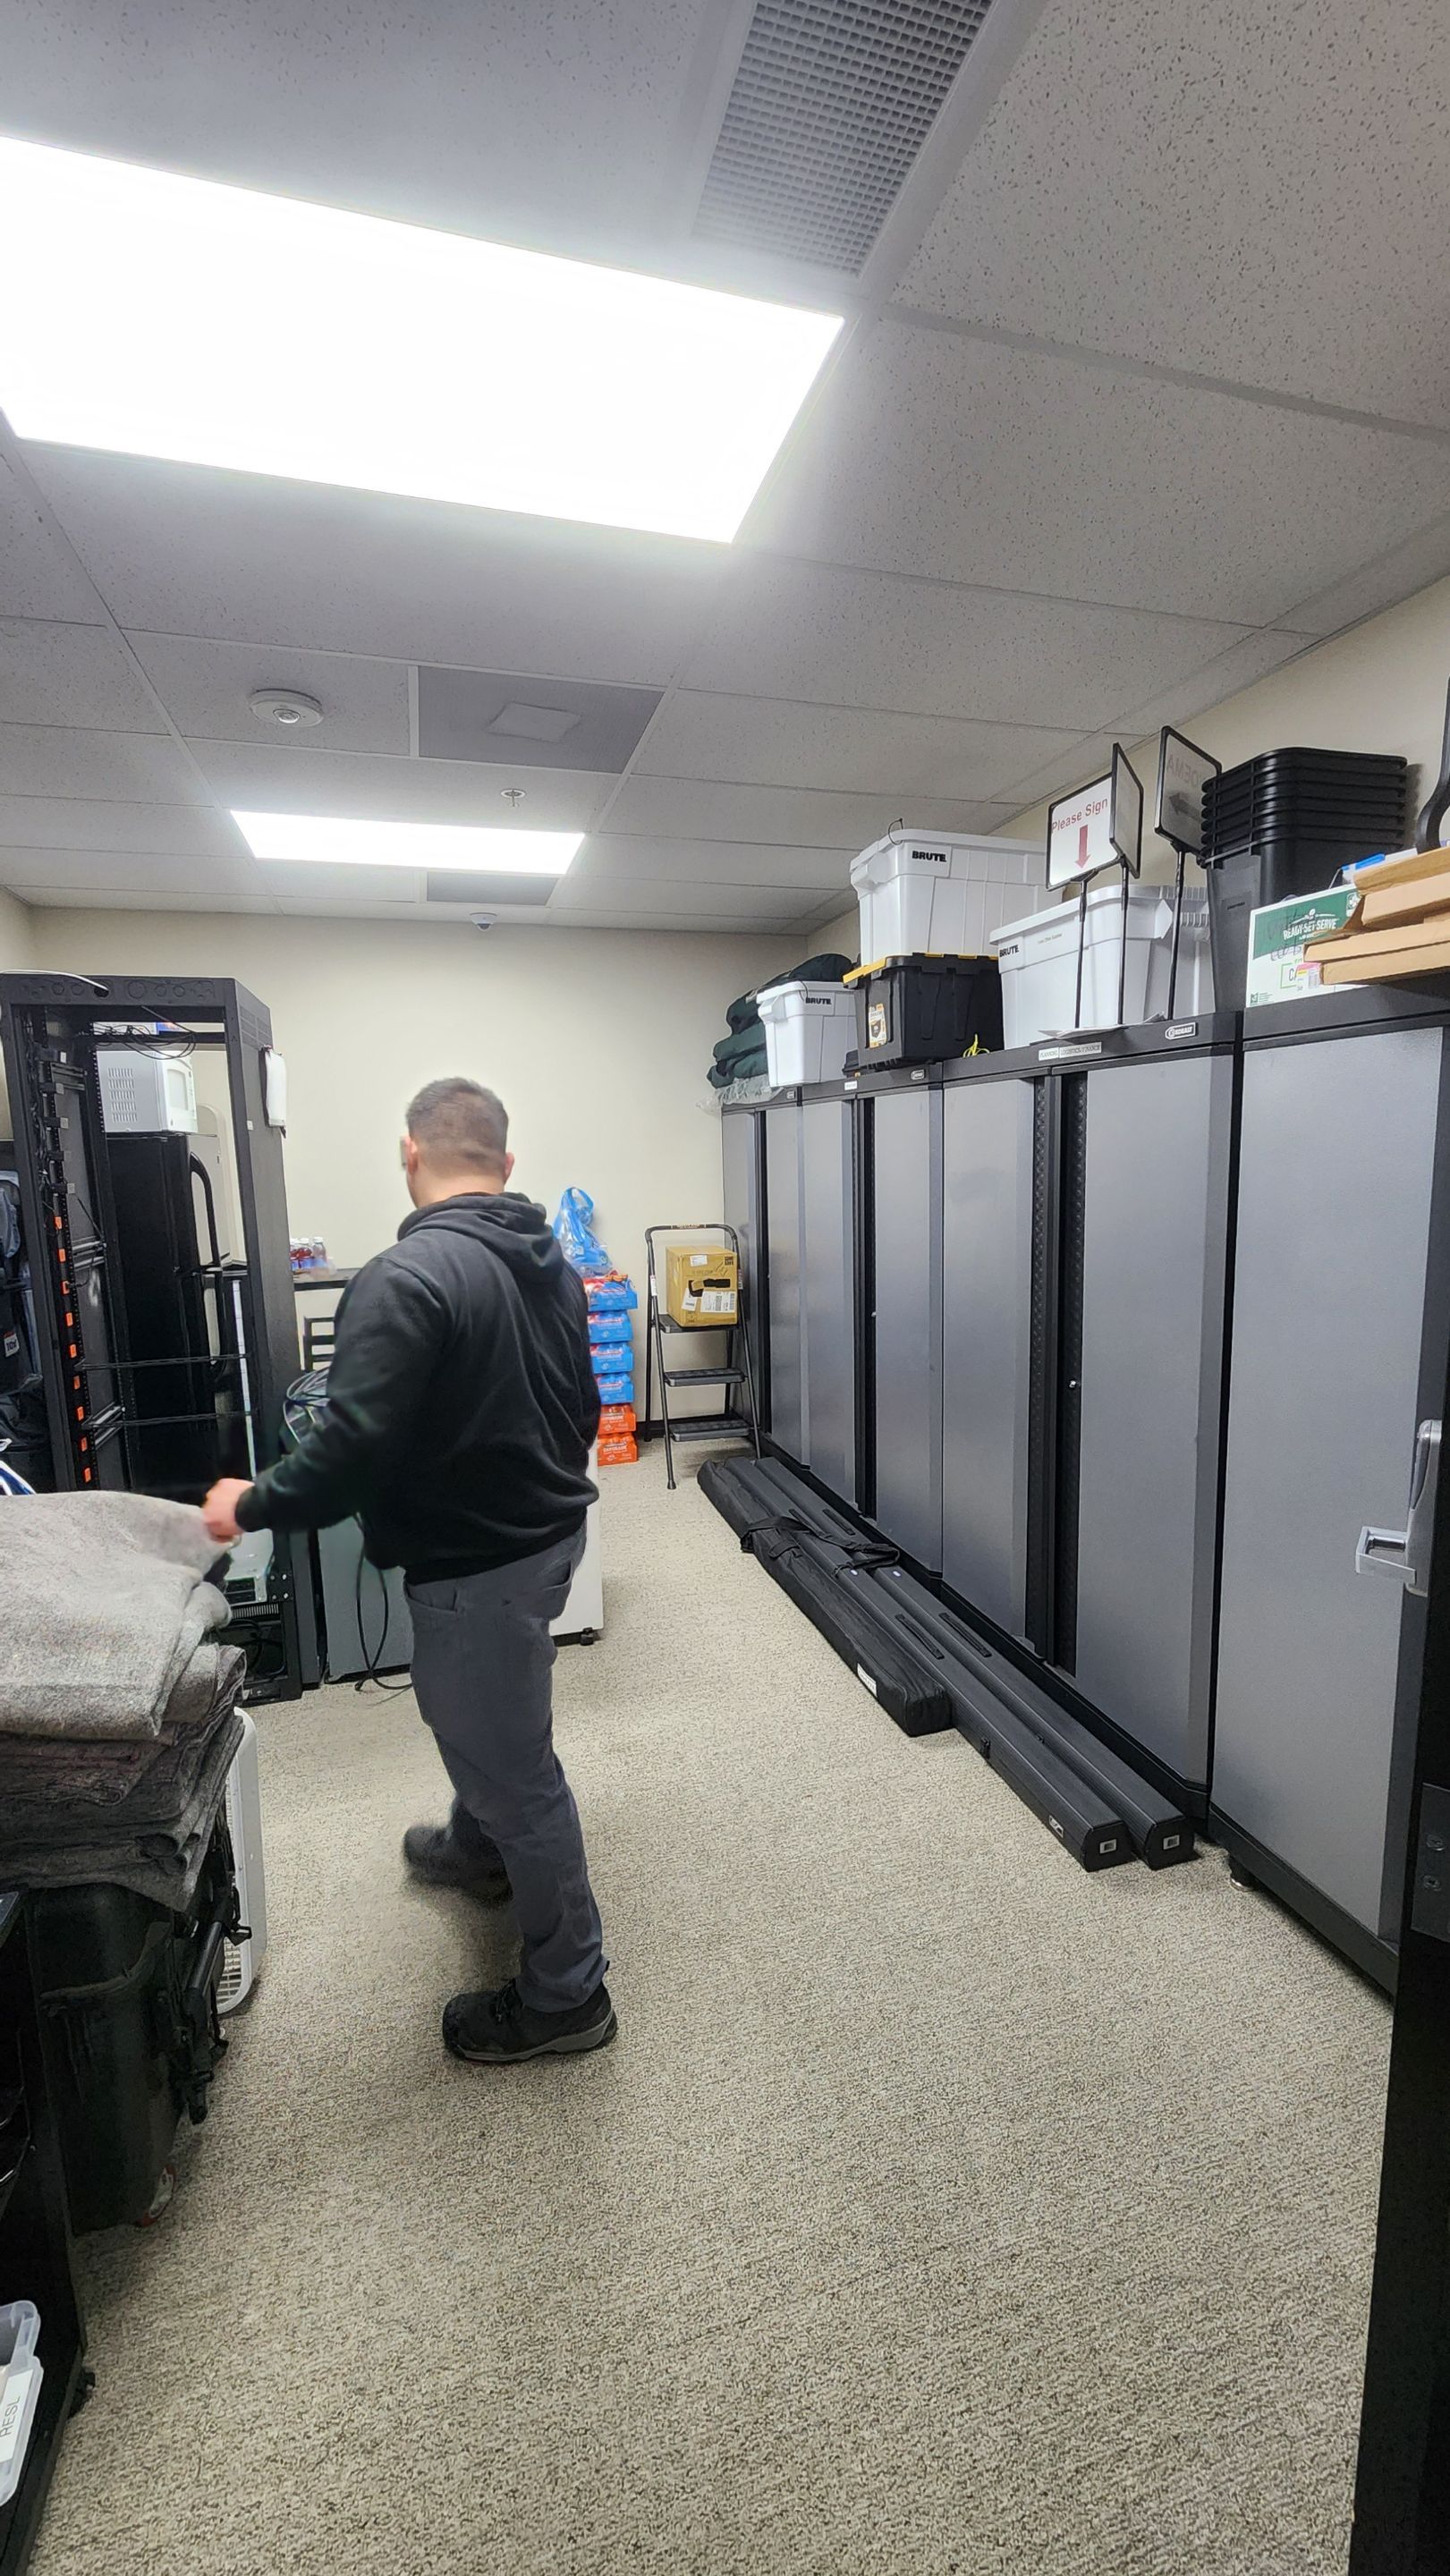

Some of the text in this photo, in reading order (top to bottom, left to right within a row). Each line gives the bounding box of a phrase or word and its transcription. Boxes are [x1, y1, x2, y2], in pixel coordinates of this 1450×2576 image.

[1052, 798, 1108, 834] Please Sign
[912, 851, 947, 862] BRUTE
[999, 945, 1020, 957] BRUTE
[805, 997, 832, 1005] BRUTE
